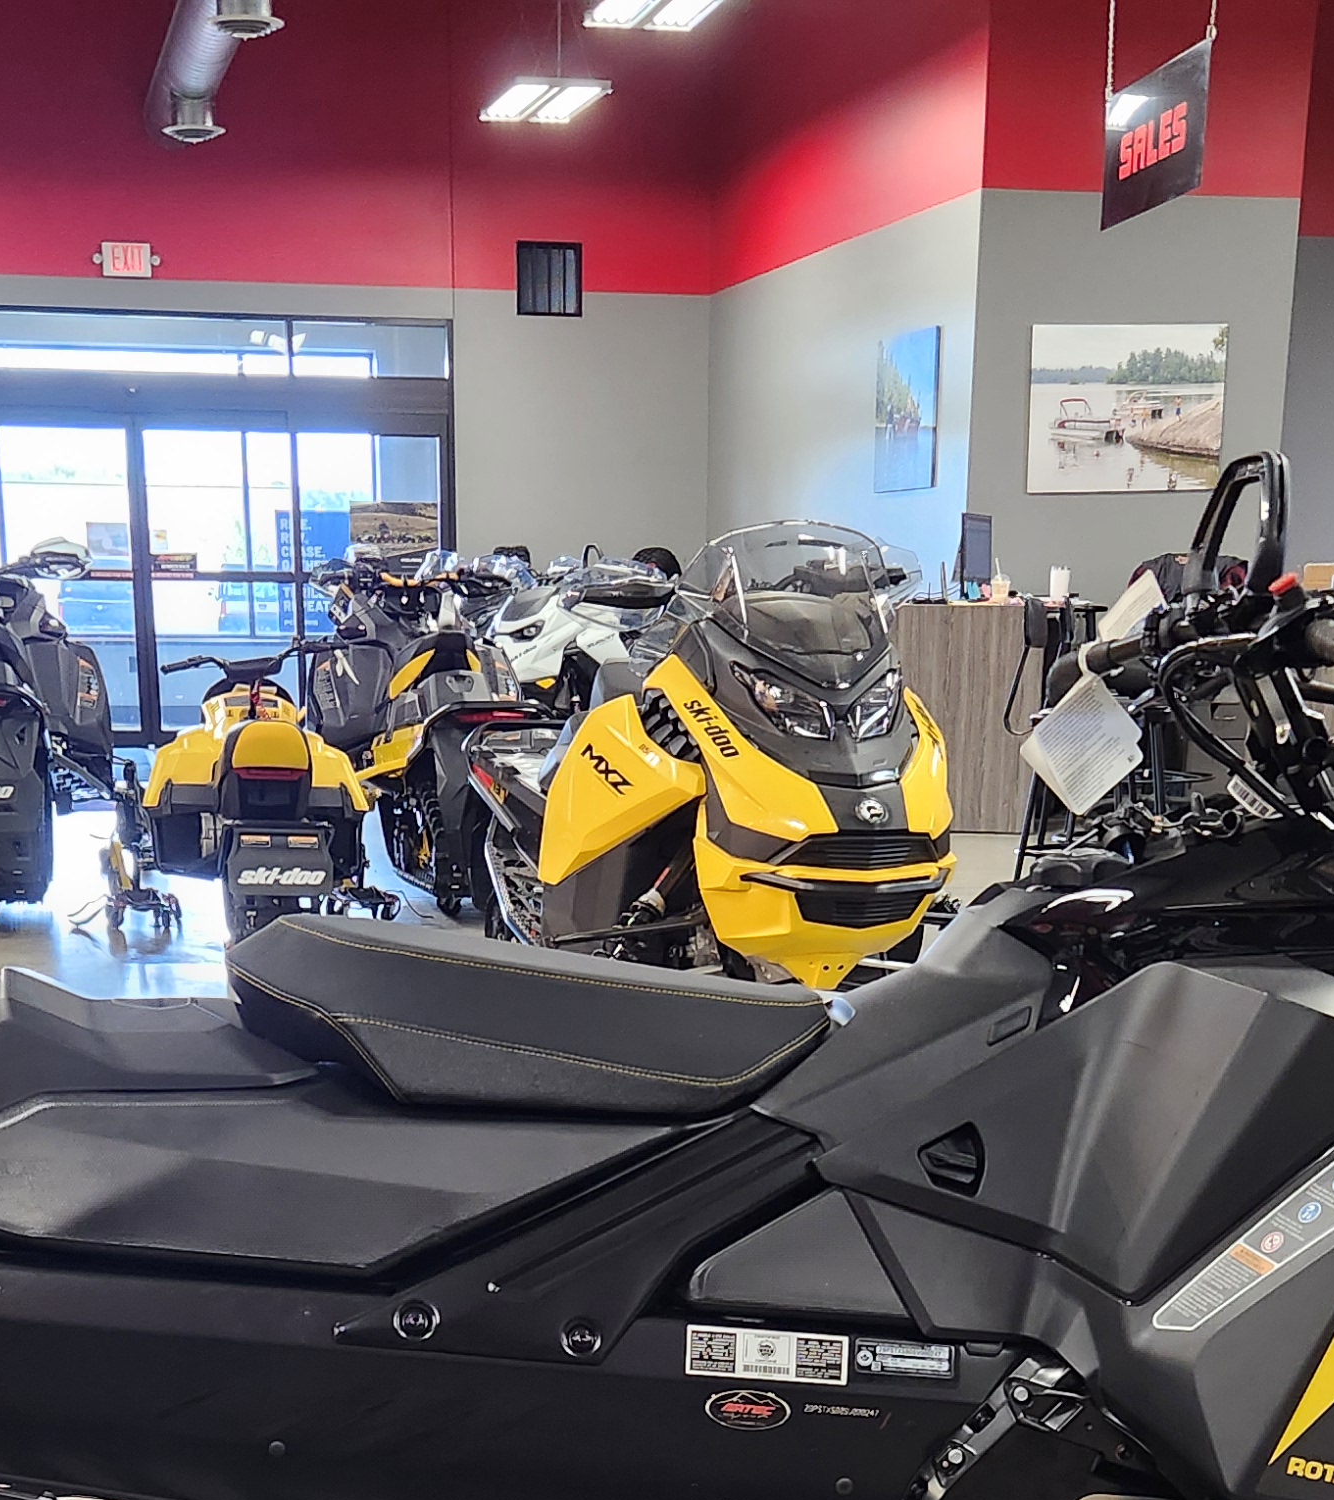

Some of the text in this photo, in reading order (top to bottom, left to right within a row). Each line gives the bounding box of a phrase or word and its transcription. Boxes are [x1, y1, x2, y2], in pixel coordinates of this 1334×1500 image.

[1118, 101, 1187, 181] SALES
[112, 245, 143, 271] EXIT
[683, 700, 740, 758] ski-doo
[580, 743, 635, 796] MXZ
[237, 866, 327, 886] ski-doo
